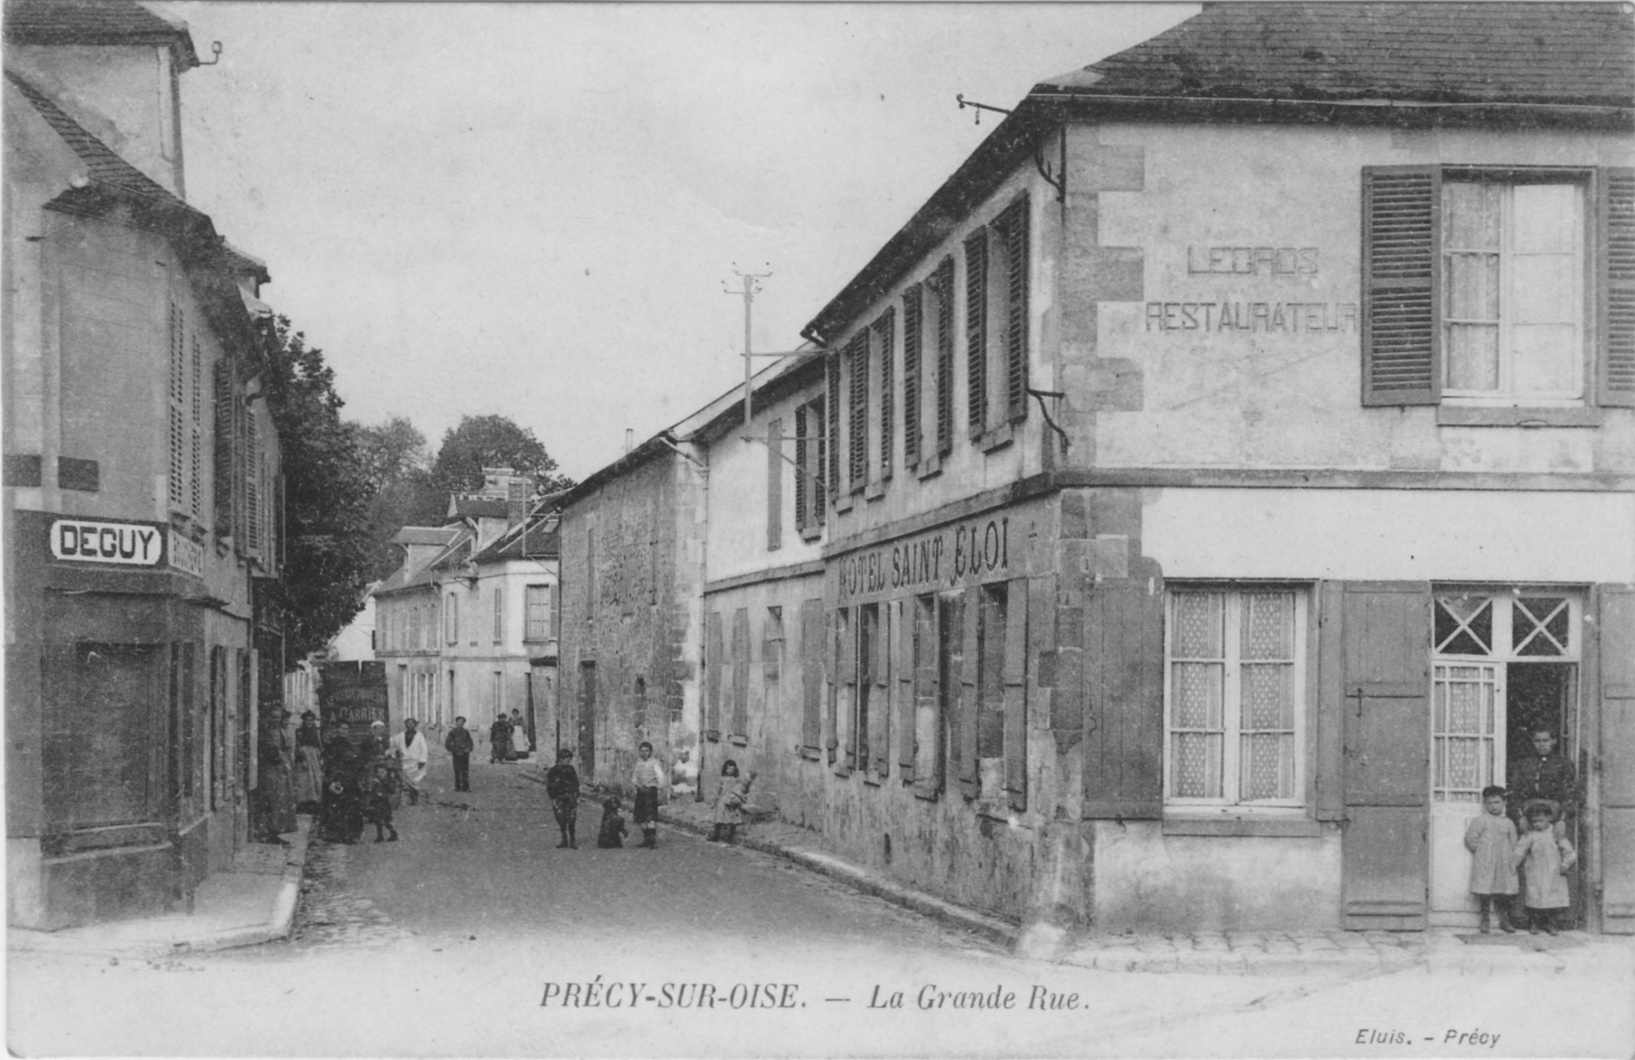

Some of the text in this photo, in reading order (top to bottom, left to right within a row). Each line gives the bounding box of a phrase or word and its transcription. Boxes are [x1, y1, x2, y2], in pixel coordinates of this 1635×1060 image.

[1146, 302, 1358, 332] RESTAURATEUR
[60, 524, 154, 561] DEGUY
[838, 517, 1008, 603] HOTEL SAINT ELOI
